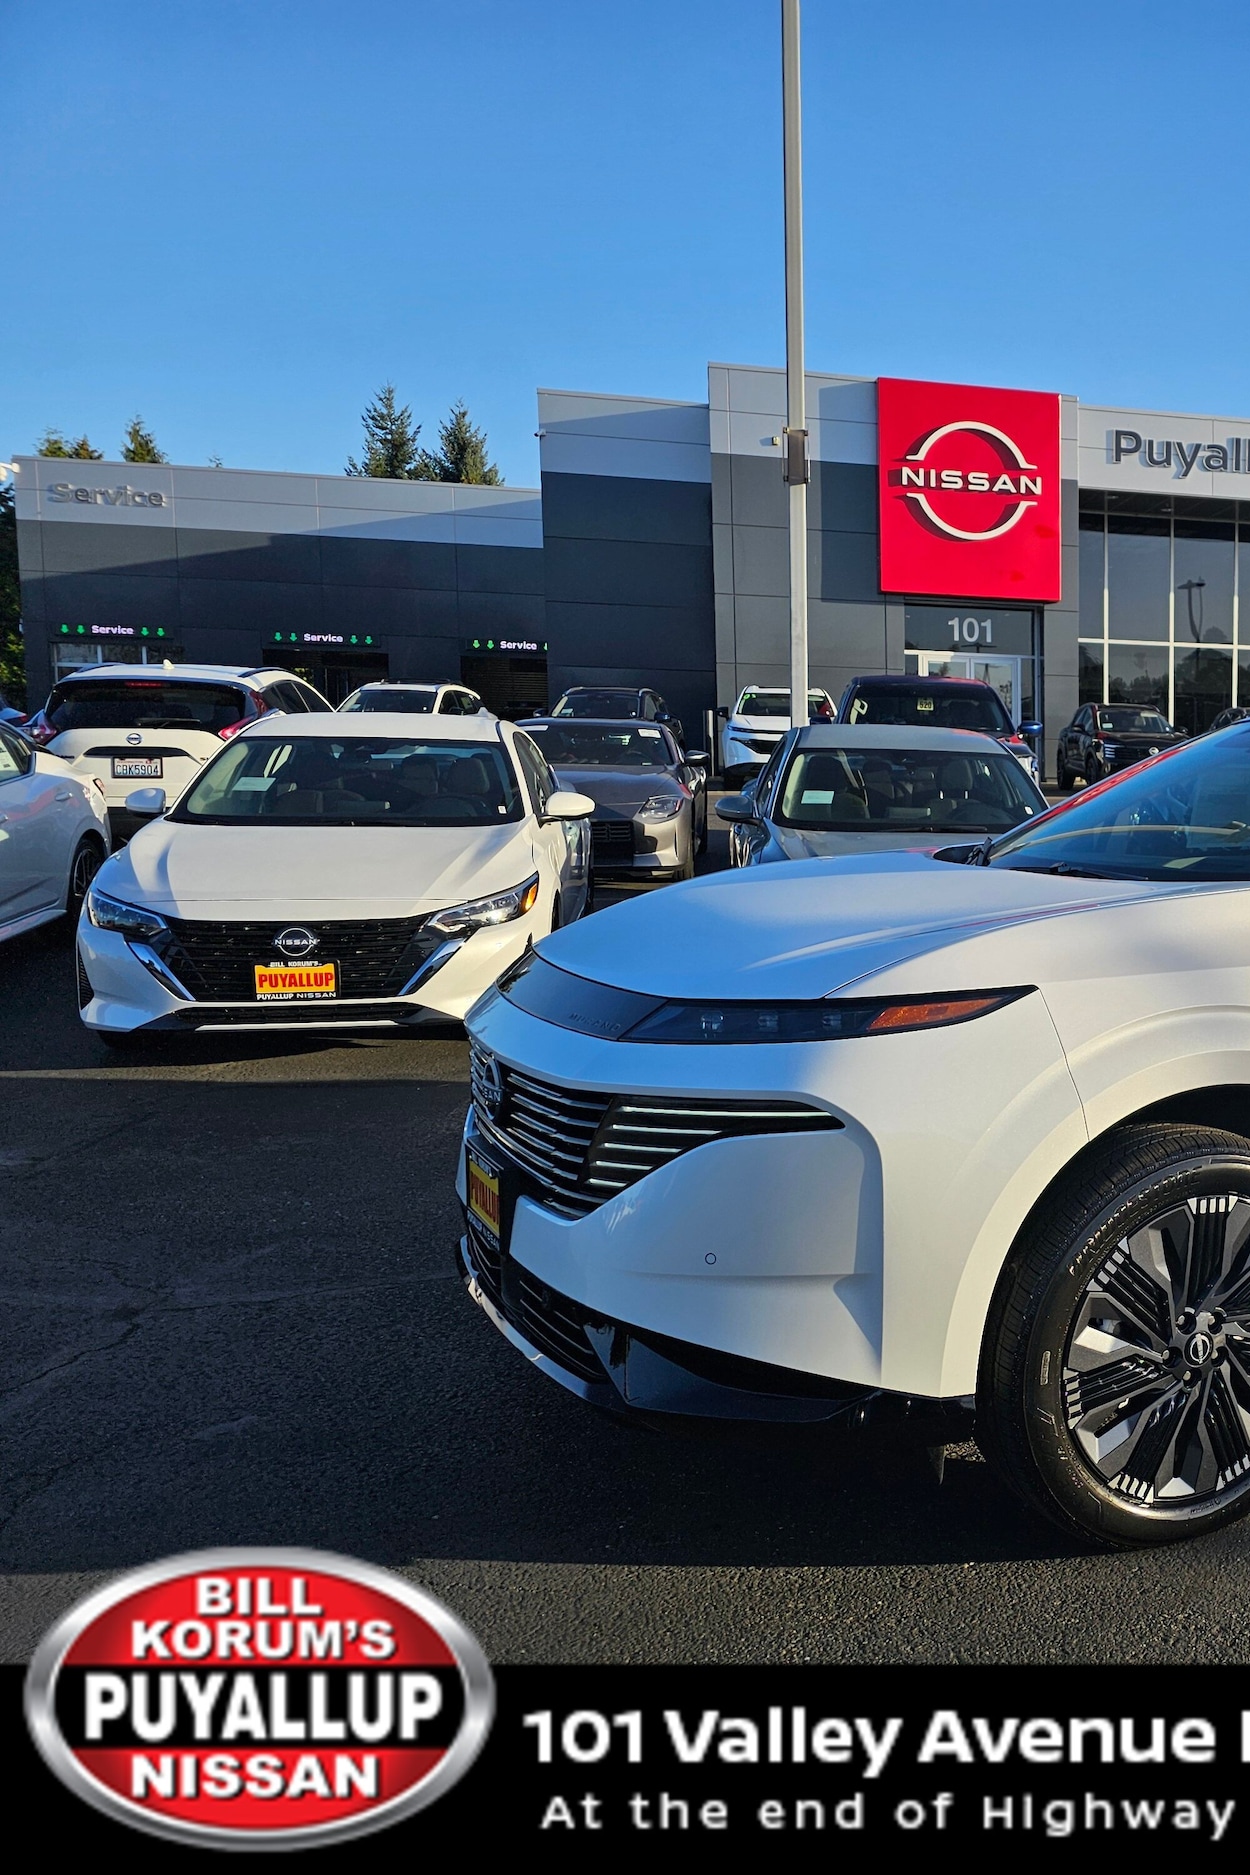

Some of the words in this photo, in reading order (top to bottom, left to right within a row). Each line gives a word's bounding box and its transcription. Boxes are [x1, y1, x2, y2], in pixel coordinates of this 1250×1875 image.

[901, 466, 1042, 495] NISSAN
[48, 483, 166, 508] Service
[91, 625, 134, 635] Service
[948, 617, 992, 643] 101
[303, 633, 344, 643] Service
[500, 641, 537, 650] Service
[116, 764, 159, 776] CBK5904
[258, 972, 334, 988] PUYALLUP
